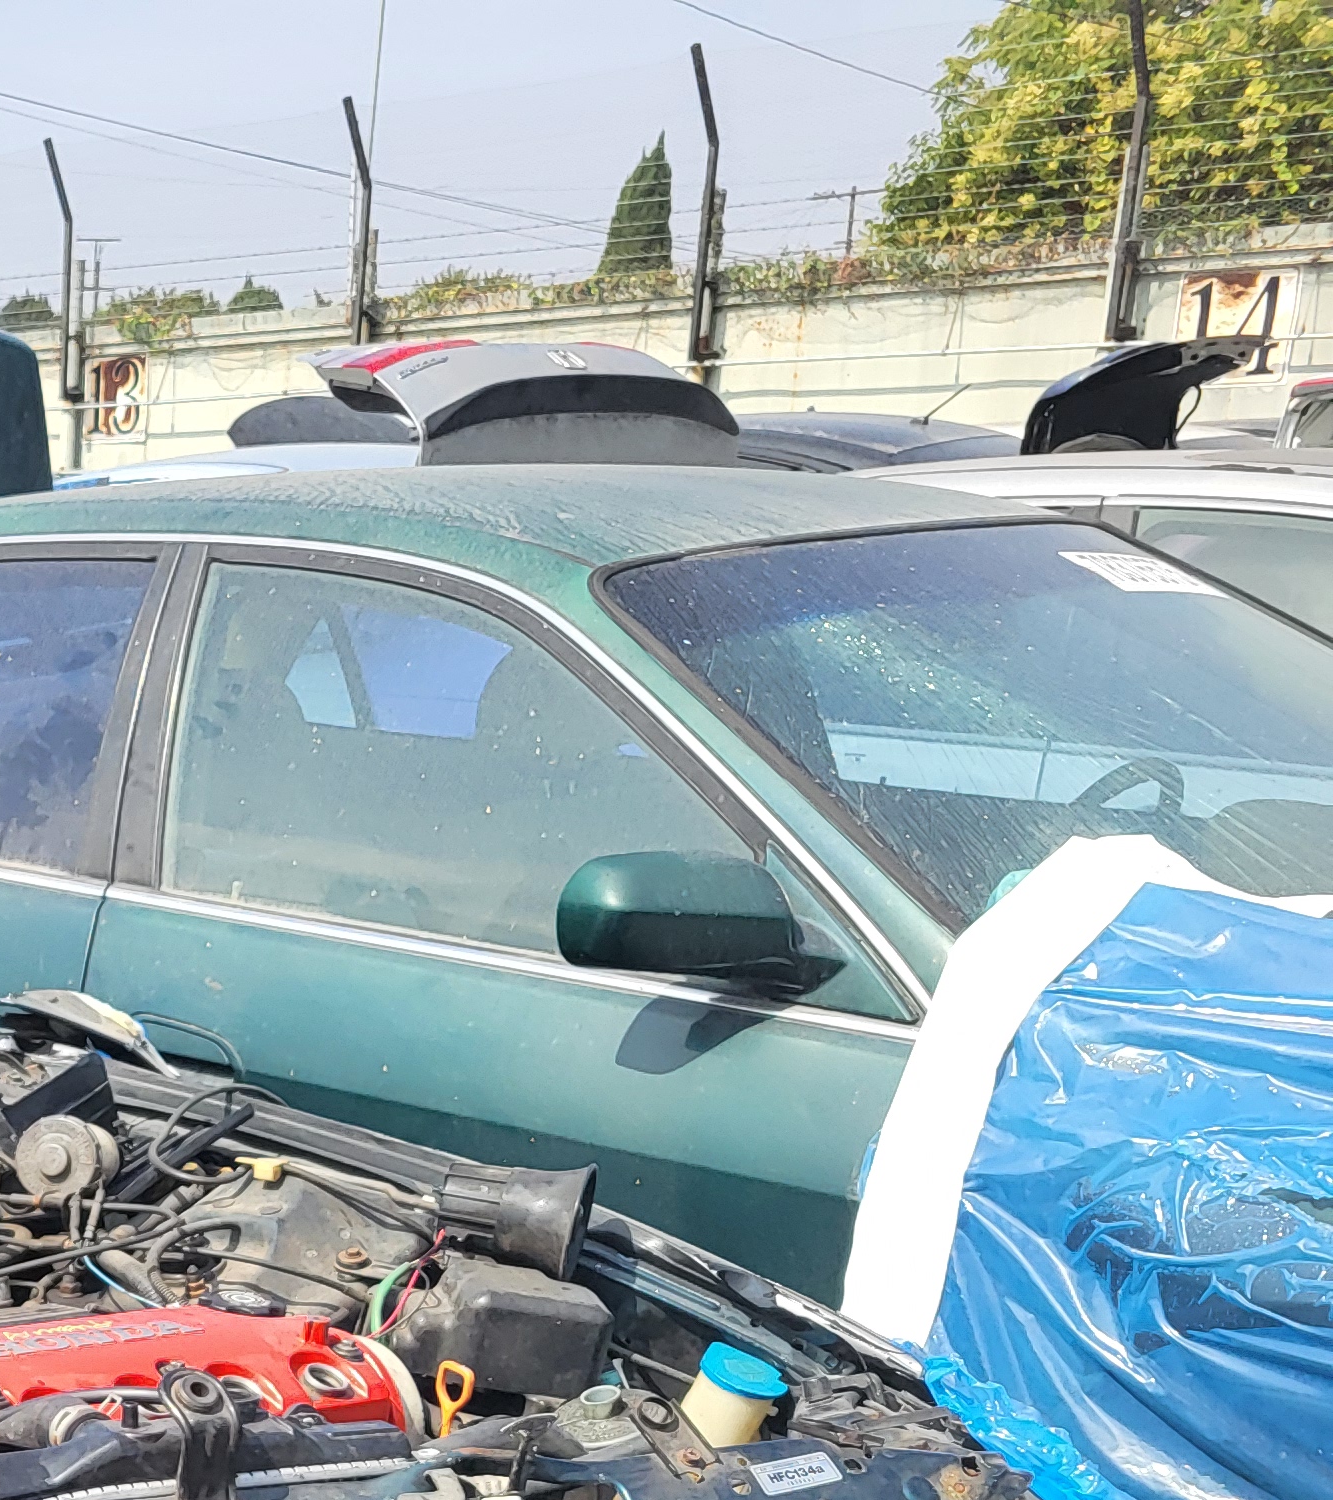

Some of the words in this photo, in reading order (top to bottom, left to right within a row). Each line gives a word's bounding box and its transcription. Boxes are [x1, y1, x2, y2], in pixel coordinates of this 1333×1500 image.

[1189, 275, 1281, 375] 14
[86, 359, 140, 435] 13
[766, 1465, 826, 1484] HFC134a
